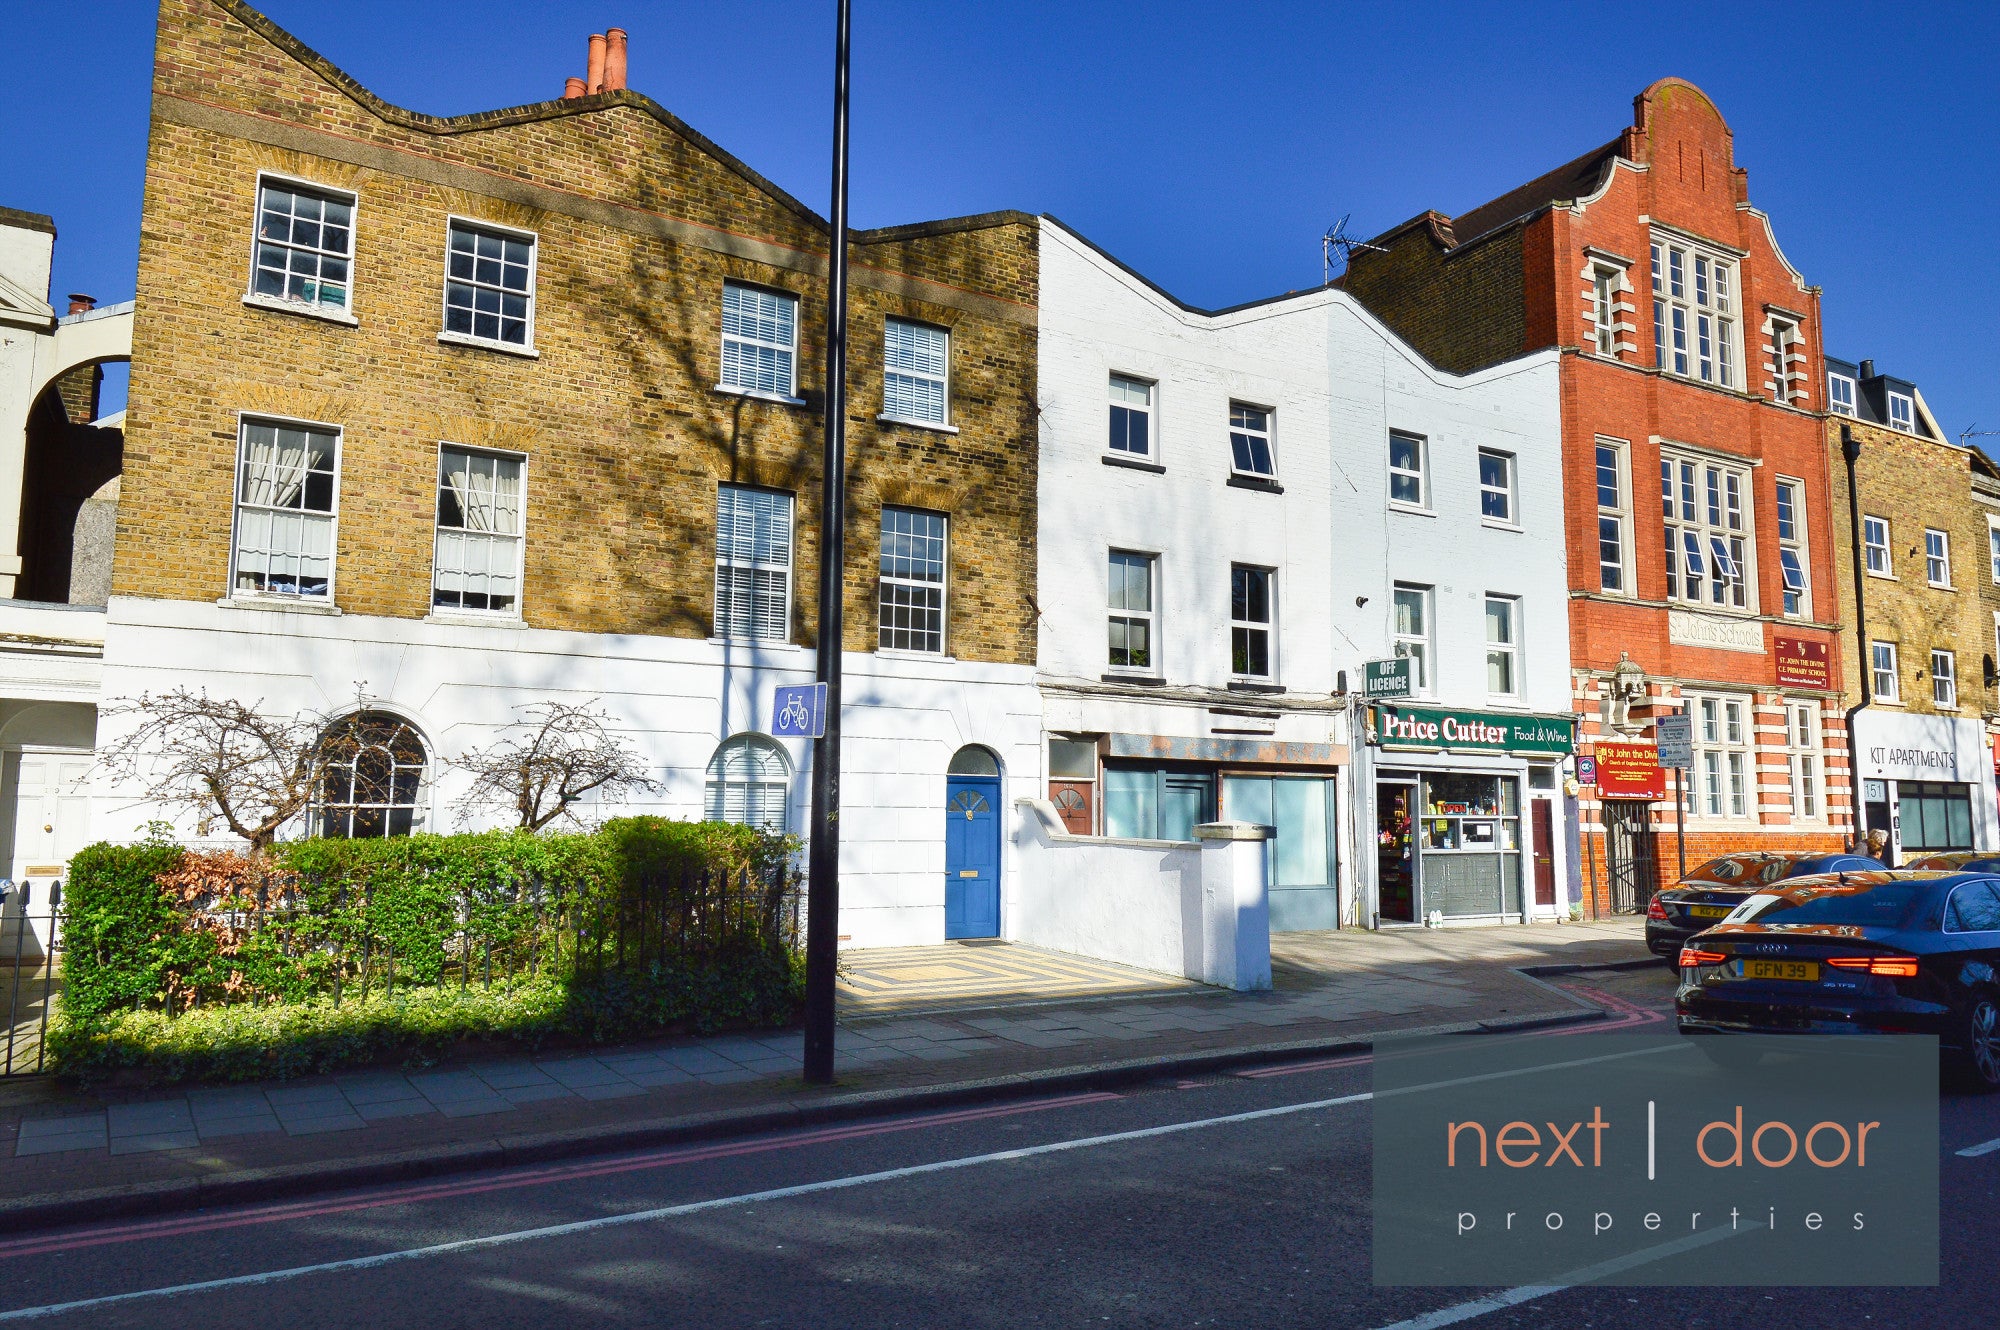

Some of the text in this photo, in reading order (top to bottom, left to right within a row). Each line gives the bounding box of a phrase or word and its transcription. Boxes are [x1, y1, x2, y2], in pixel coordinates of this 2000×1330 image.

[1379, 661, 1396, 675] OFF
[1787, 658, 1800, 666] JOHN
[1787, 667, 1807, 675] PRIMARY
[1369, 676, 1407, 692] LICENCE
[1382, 713, 1568, 744] Price Cutter Food & Wine
[1607, 748, 1614, 758] St
[1615, 748, 1631, 759] John
[1632, 749, 1644, 759] the
[1870, 747, 1955, 768] KIT APARTMENTS
[1865, 782, 1882, 798] 151
[1699, 906, 1724, 917] KG 27
[1754, 963, 1807, 978] GFN 39
